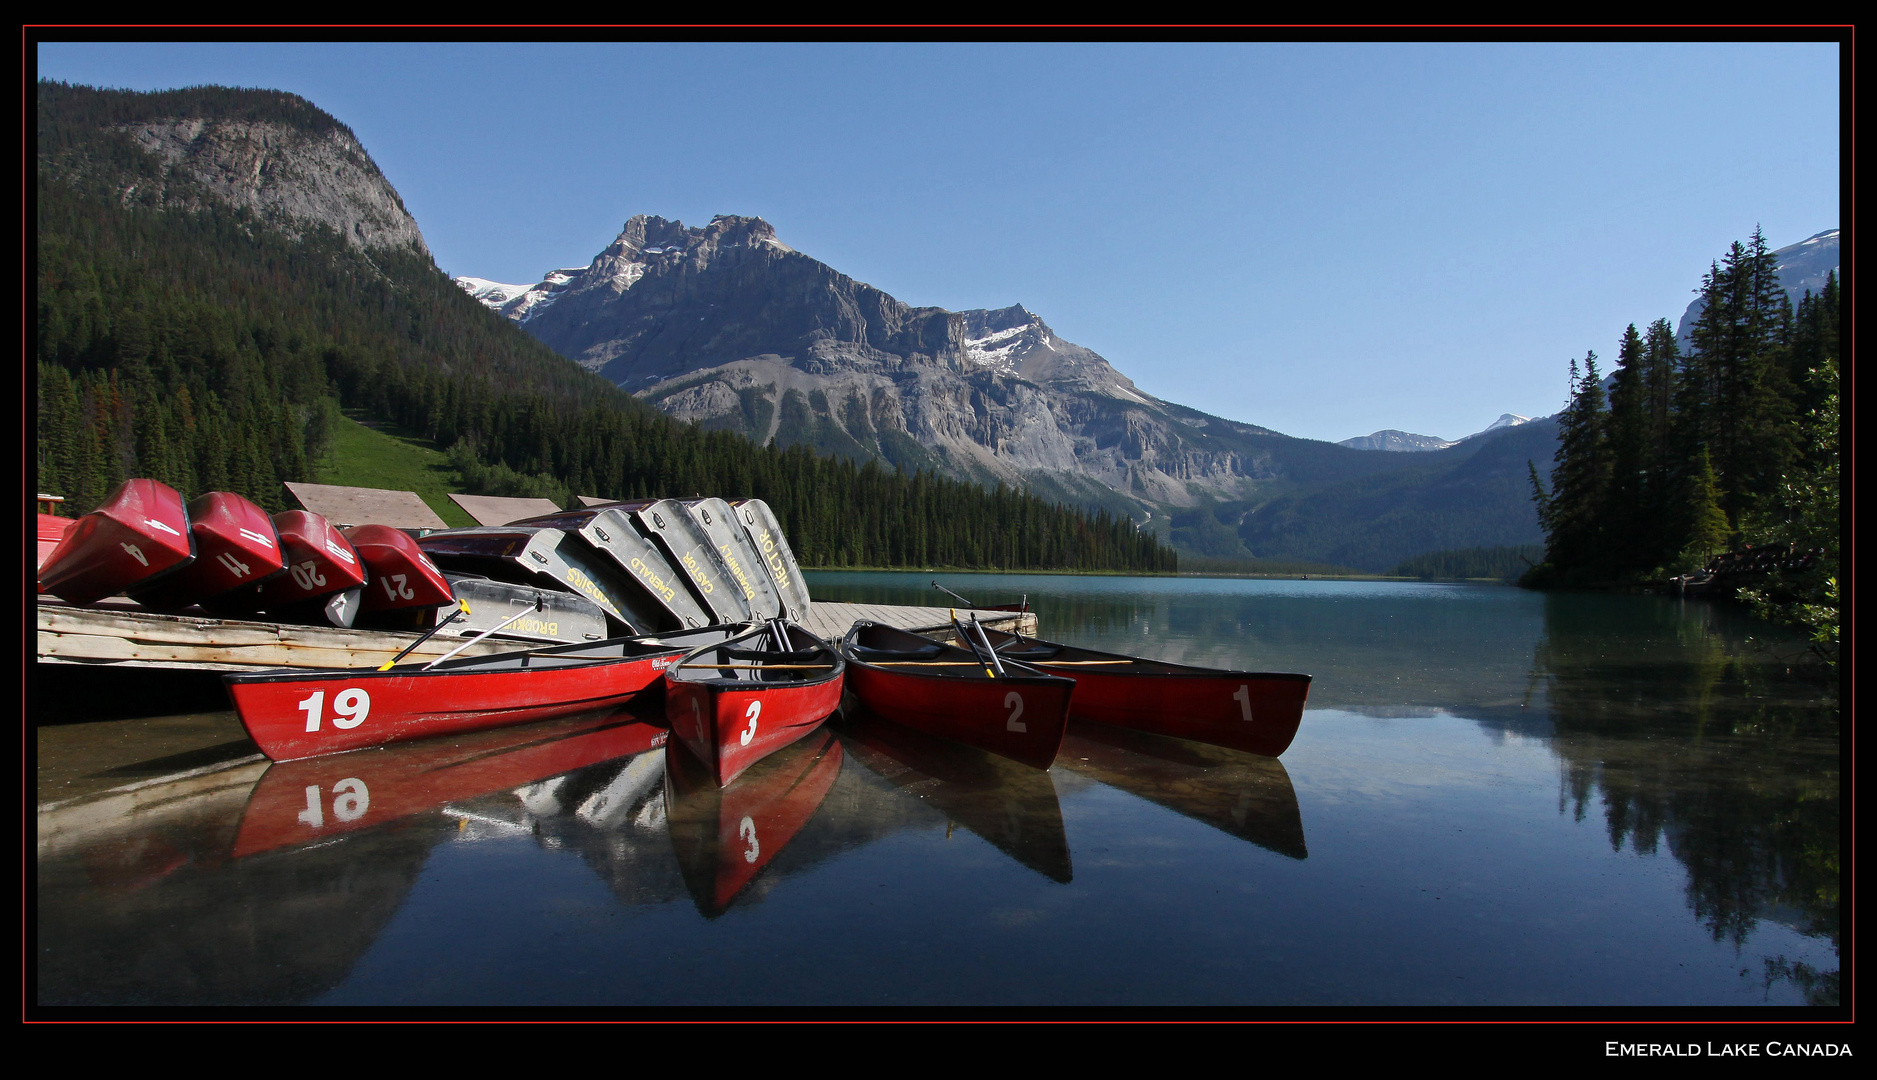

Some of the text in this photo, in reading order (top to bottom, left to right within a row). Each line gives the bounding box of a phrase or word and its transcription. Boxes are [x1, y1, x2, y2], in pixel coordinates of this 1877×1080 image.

[143, 518, 180, 537] 4
[239, 527, 274, 549] 11
[120, 541, 149, 567] 4
[216, 551, 251, 579] 11
[682, 551, 714, 594] CASTOR
[720, 543, 756, 601] DRAGONFLY
[759, 528, 790, 590] HECTOR
[290, 560, 327, 591] 20
[380, 573, 415, 602] 21
[630, 557, 676, 603] EMERALD
[298, 687, 371, 734] 19
[691, 696, 704, 744] 3
[740, 700, 762, 747] 3
[1004, 691, 1027, 733] 2
[1233, 684, 1254, 721] 1
